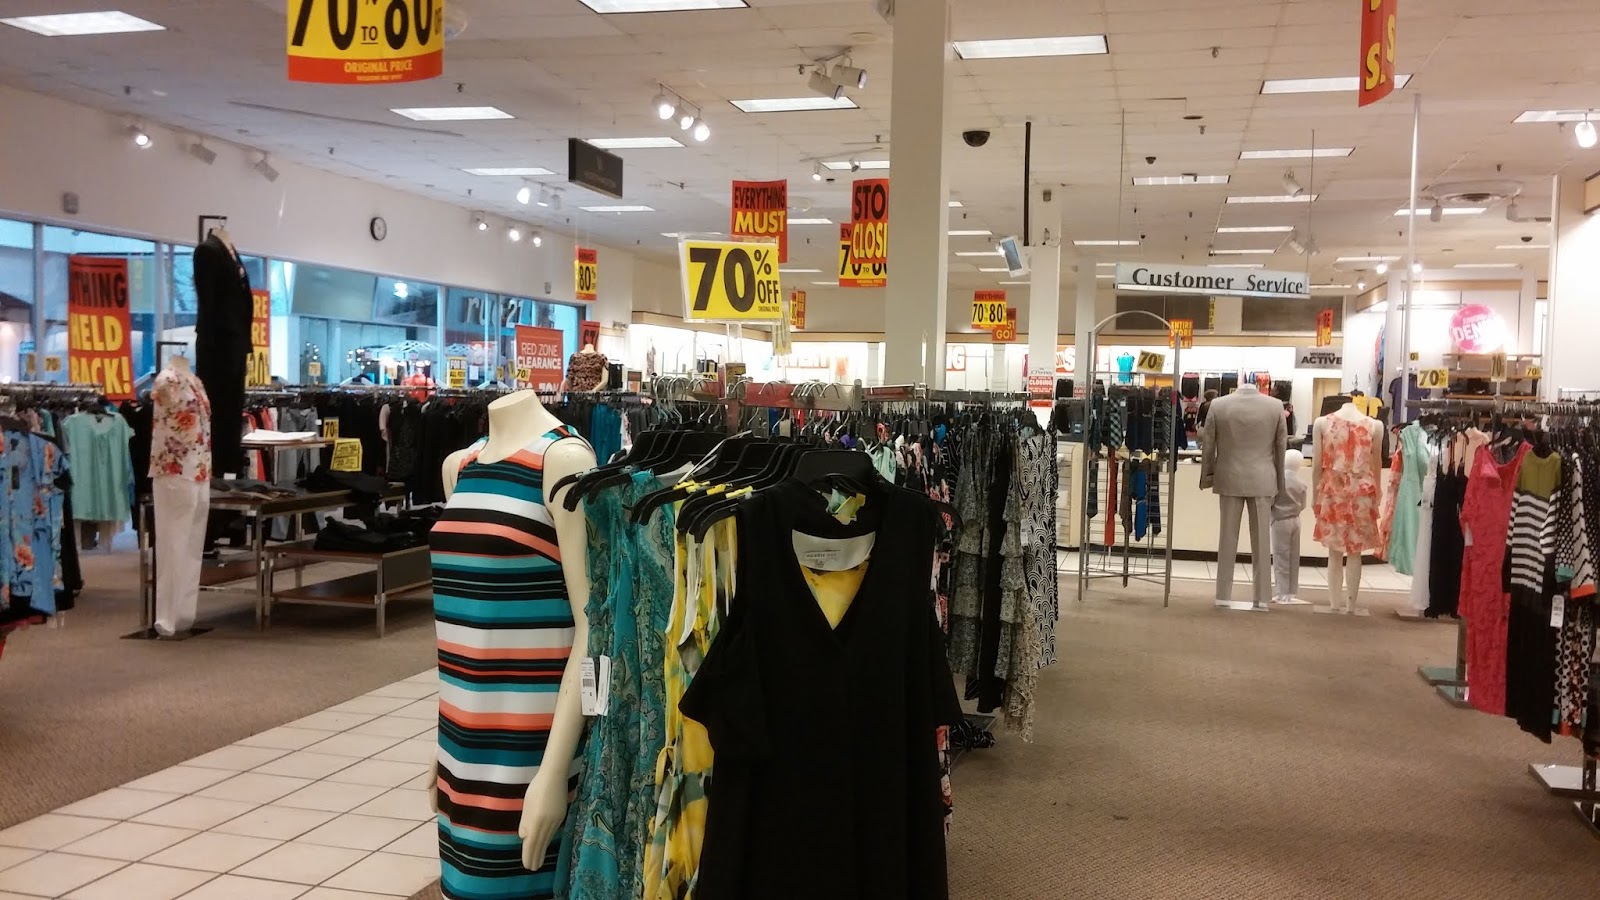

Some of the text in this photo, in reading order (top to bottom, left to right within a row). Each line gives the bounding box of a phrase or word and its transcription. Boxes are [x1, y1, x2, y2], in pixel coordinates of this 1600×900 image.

[361, 26, 378, 45] TO
[344, 59, 413, 74] ORIGINAL PRICE
[734, 184, 786, 210] EVERYTHING
[854, 183, 889, 221] STO
[734, 210, 786, 234] MUST
[757, 279, 779, 304] OFF
[1132, 267, 1304, 295] Customer Service
[71, 313, 124, 351] HELD
[995, 329, 1013, 340] GO!
[1451, 319, 1487, 342] DEN
[521, 342, 558, 357] RED ZONE
[1170, 340, 1193, 349] SLE!
[517, 355, 562, 369] CLEARANCE
[1301, 355, 1343, 365] ACTIVE
[70, 355, 132, 394] BACK!
